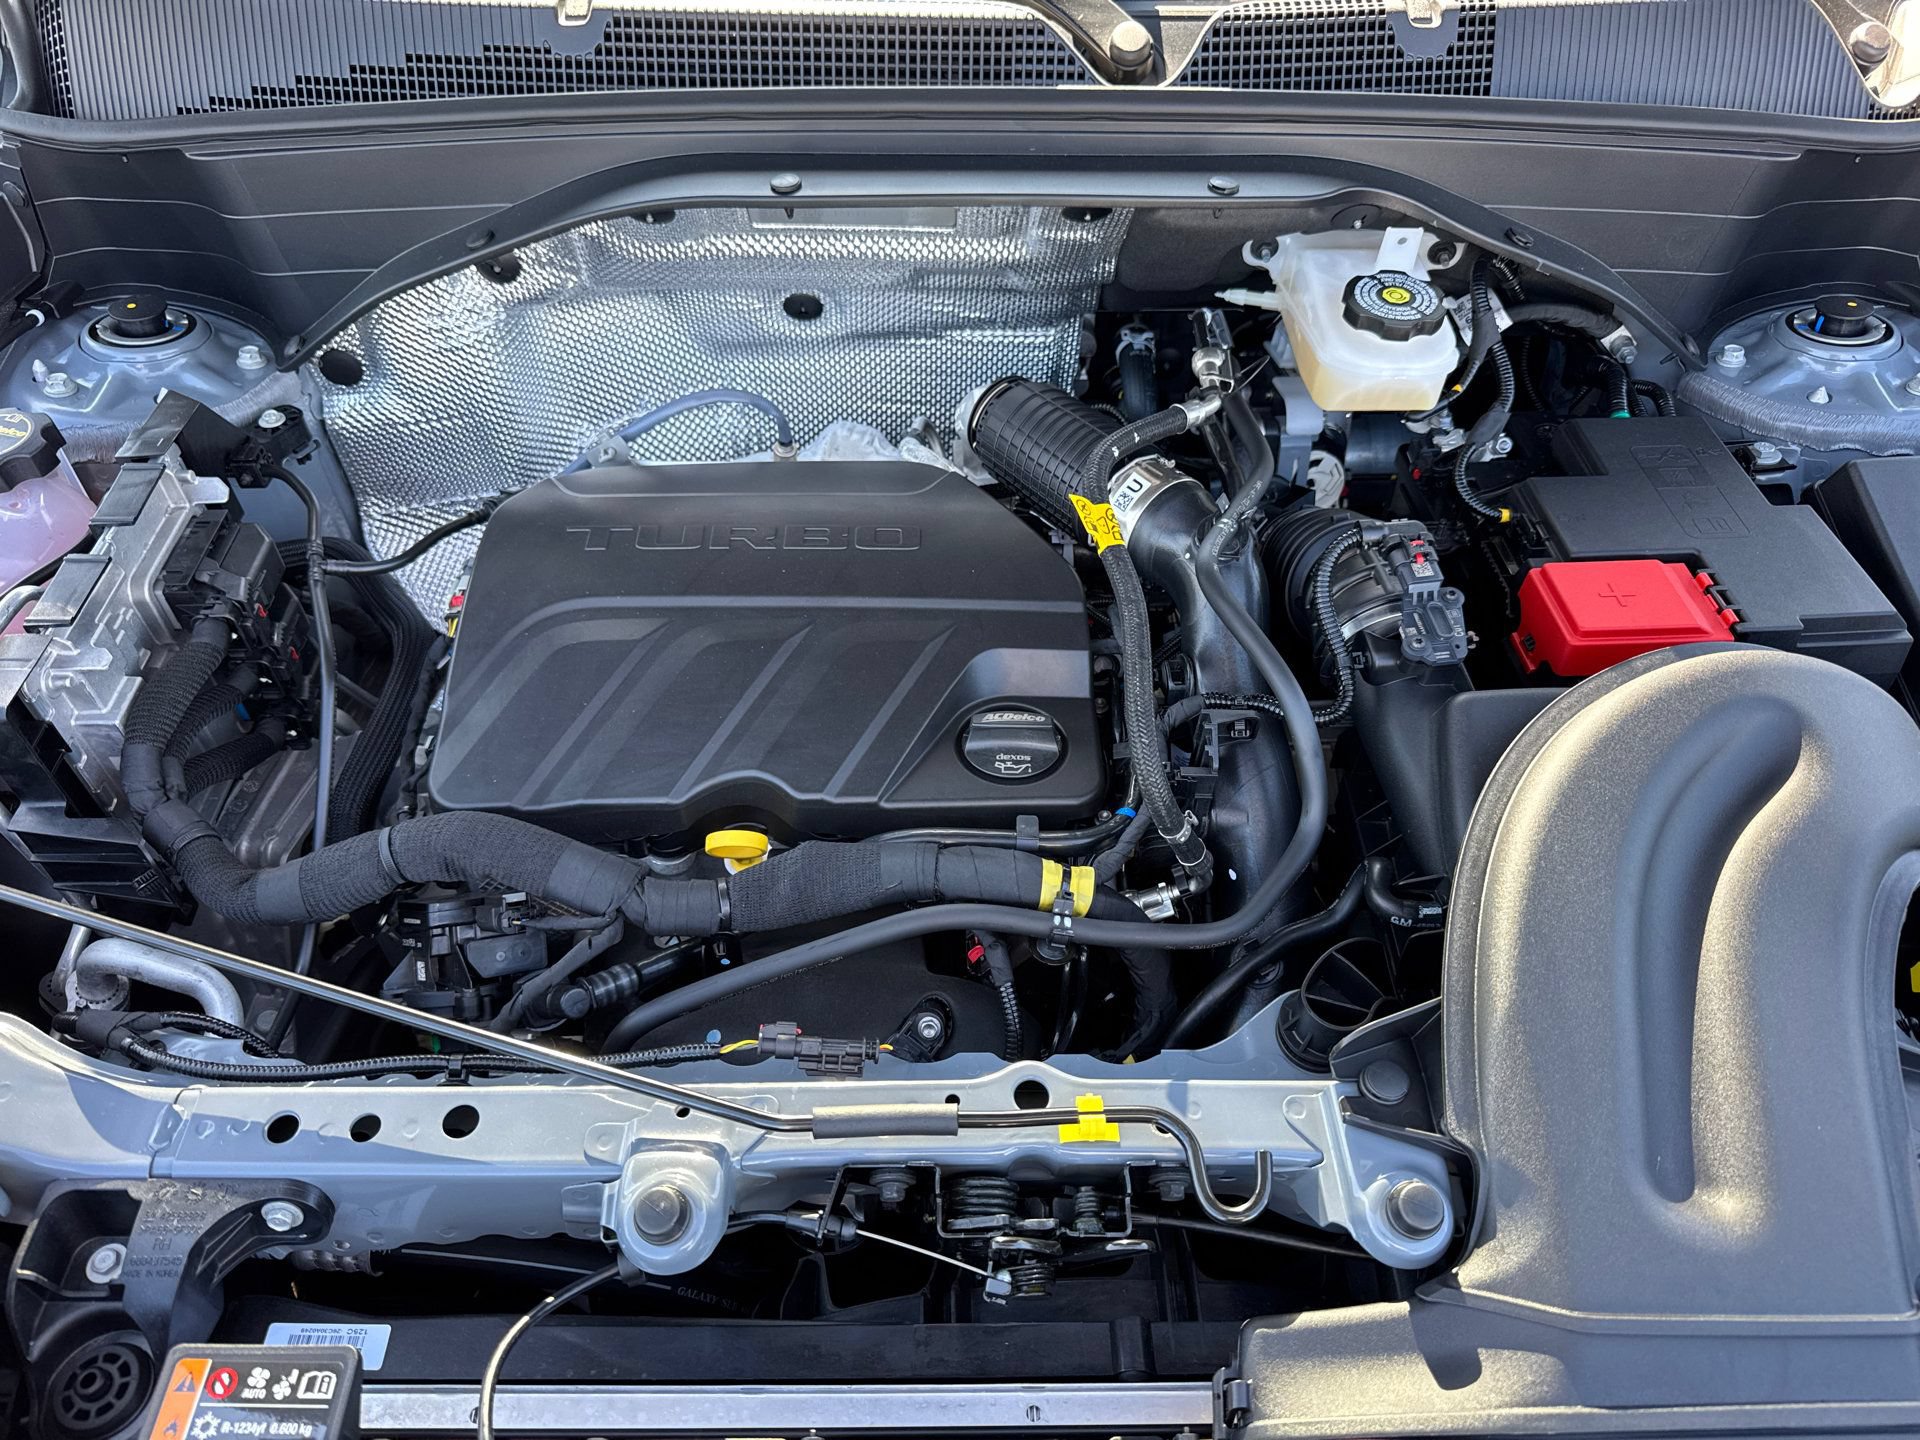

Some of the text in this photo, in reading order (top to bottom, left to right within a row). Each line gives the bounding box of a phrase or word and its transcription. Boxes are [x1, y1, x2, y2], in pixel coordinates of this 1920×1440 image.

[565, 523, 924, 552] TURBO
[996, 753, 1031, 762] dexos
[1390, 916, 1413, 928] GM
[241, 1388, 267, 1399] AUTO
[299, 1423, 313, 1438] kg
